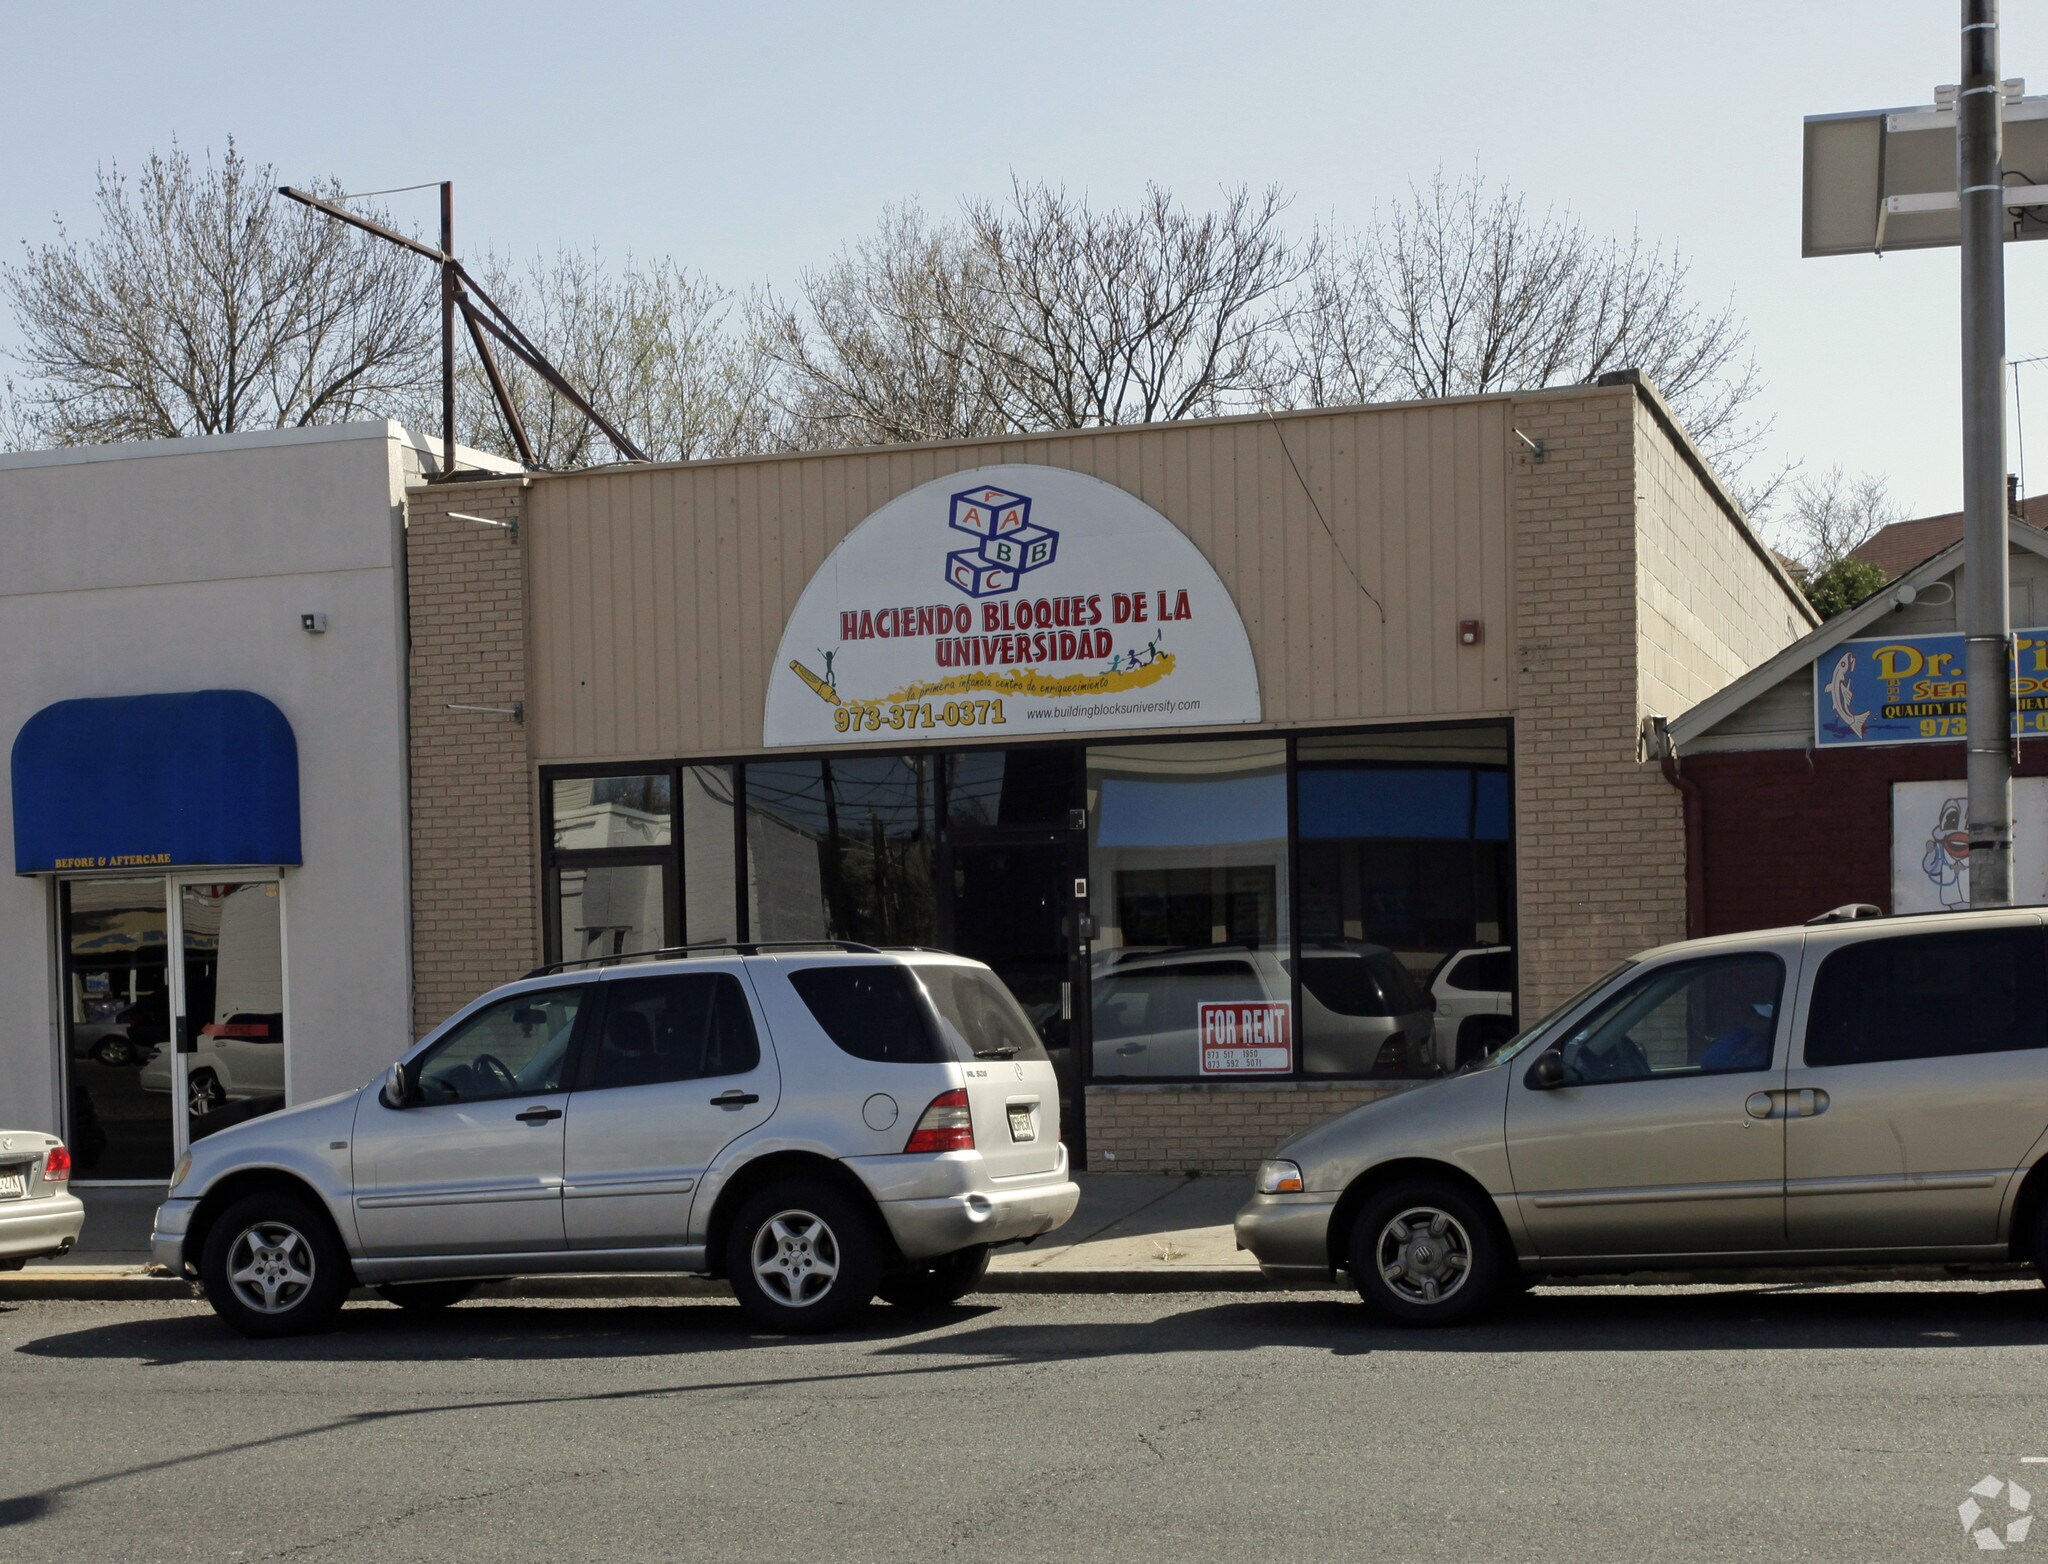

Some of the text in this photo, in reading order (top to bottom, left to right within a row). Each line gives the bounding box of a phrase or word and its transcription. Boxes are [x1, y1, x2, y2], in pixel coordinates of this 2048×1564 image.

[962, 507, 981, 527] A
[999, 509, 1020, 530] A
[996, 542, 1012, 562] B
[1031, 542, 1047, 563] B
[954, 566, 970, 587] C
[986, 570, 1002, 589] C
[840, 589, 1192, 640] HACIENDO BLOQUES DE LA
[936, 628, 1113, 667] UNIVERSIDAD
[1872, 645, 1964, 679] Dr.
[906, 674, 1109, 702] la primera infancia centro de enriquecimiento
[834, 699, 1201, 732] 973-371-0371 www.buildingblocksuniversity.com
[1885, 702, 1944, 718] QUALITY
[55, 853, 171, 868] BEFORE & AFTERCARE
[1205, 1008, 1285, 1045] FOR RENT
[1207, 1051, 1219, 1059] 973
[1223, 1050, 1234, 1058] 517
[1246, 1059, 1262, 1067] 5071
